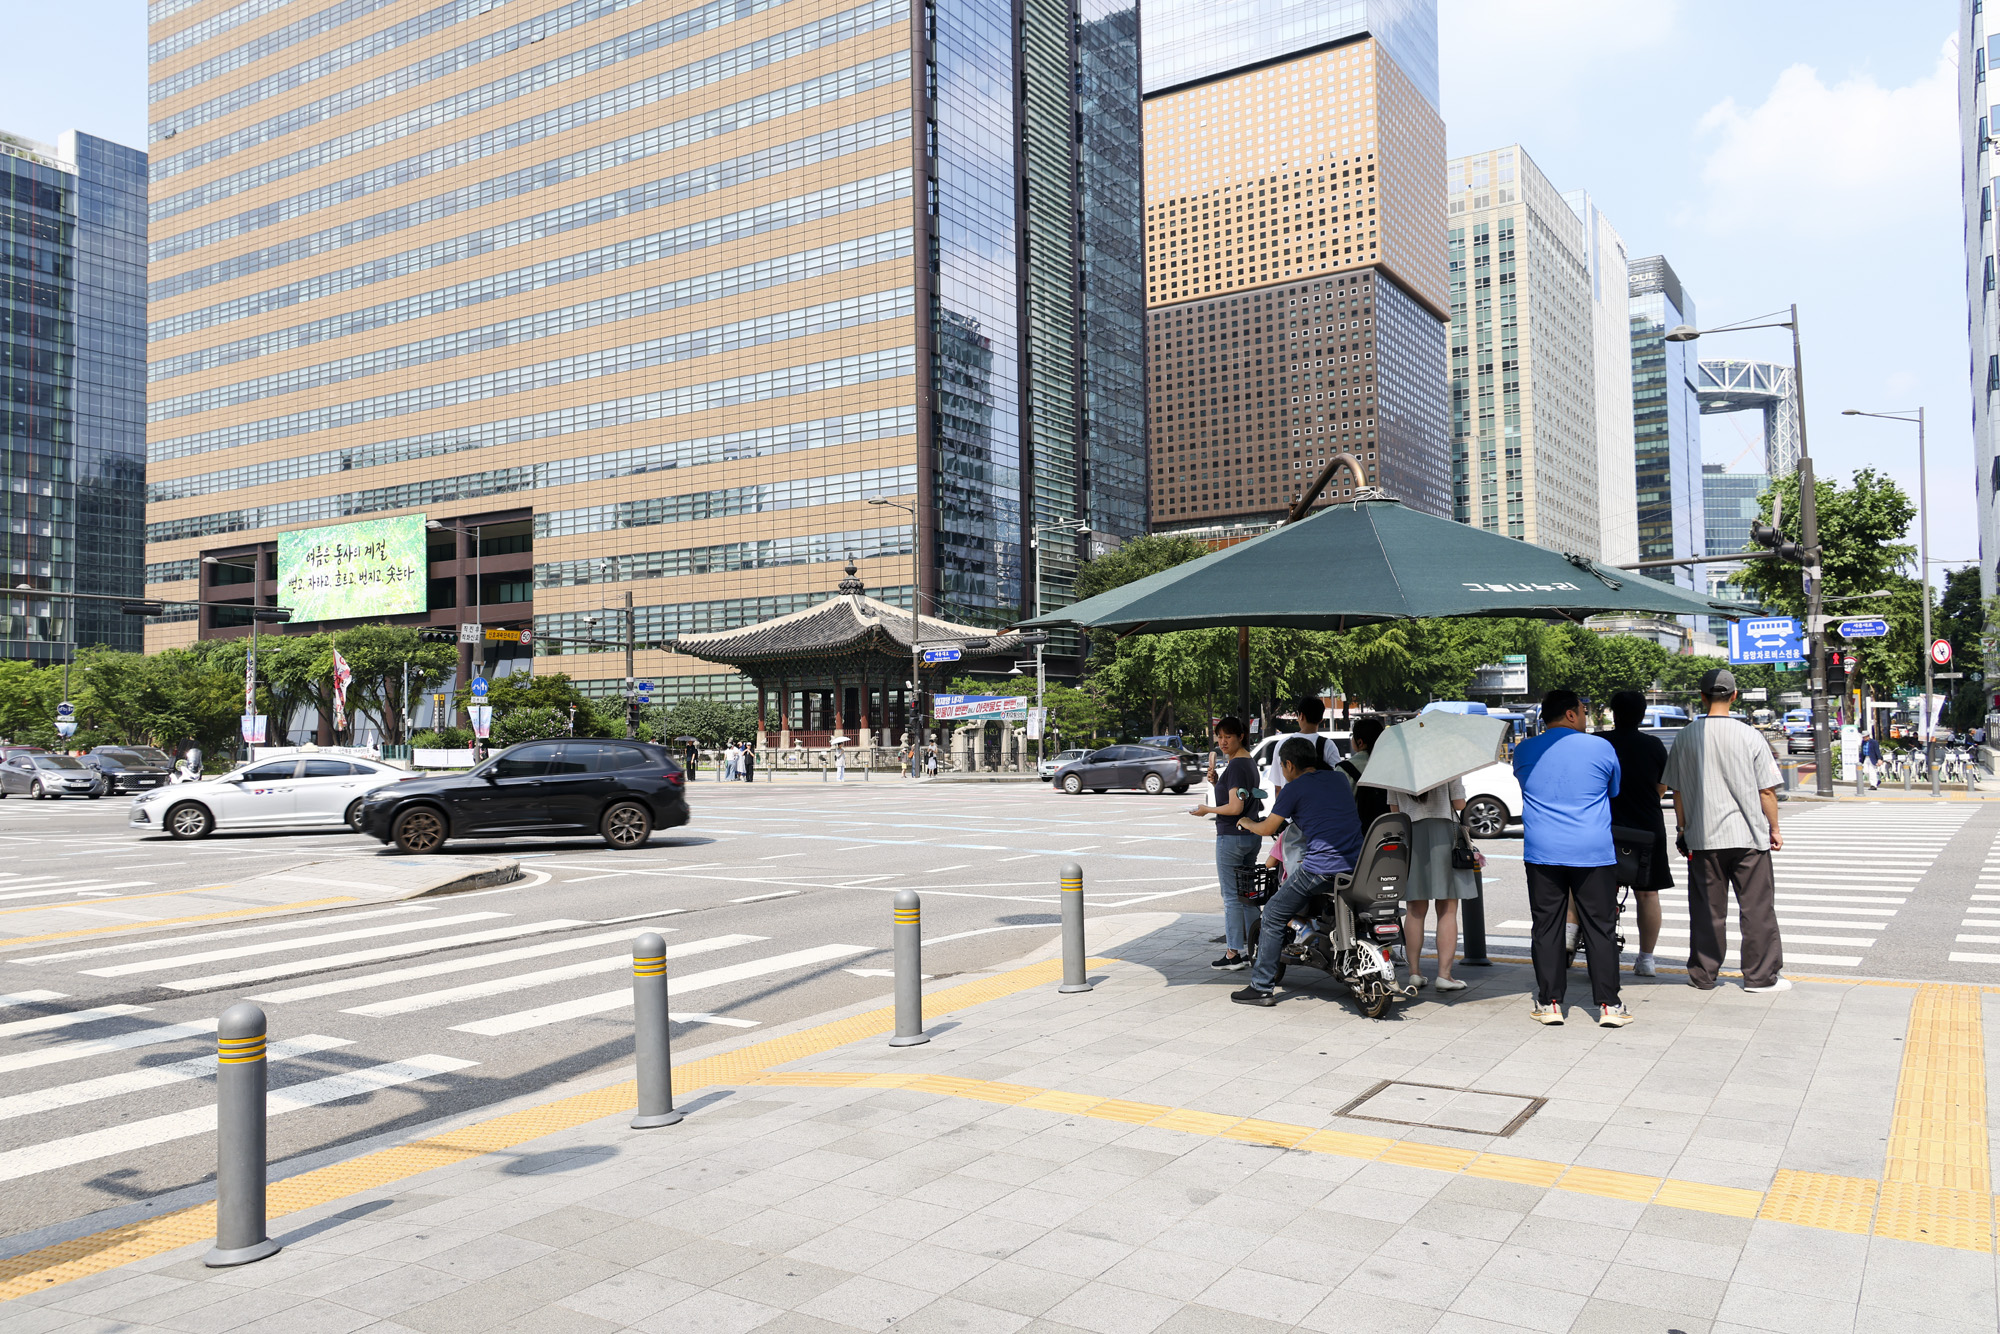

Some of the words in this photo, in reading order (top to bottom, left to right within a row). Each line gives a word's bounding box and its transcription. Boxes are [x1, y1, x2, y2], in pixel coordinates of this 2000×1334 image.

[1629, 272, 1657, 282] OUL
[306, 546, 330, 567] 여름은
[334, 543, 361, 565] 동사의
[364, 538, 388, 561] 계절
[386, 564, 415, 585] 솟는다
[522, 633, 531, 641] 50
[1742, 649, 1800, 661] 중앙차로버스전용
